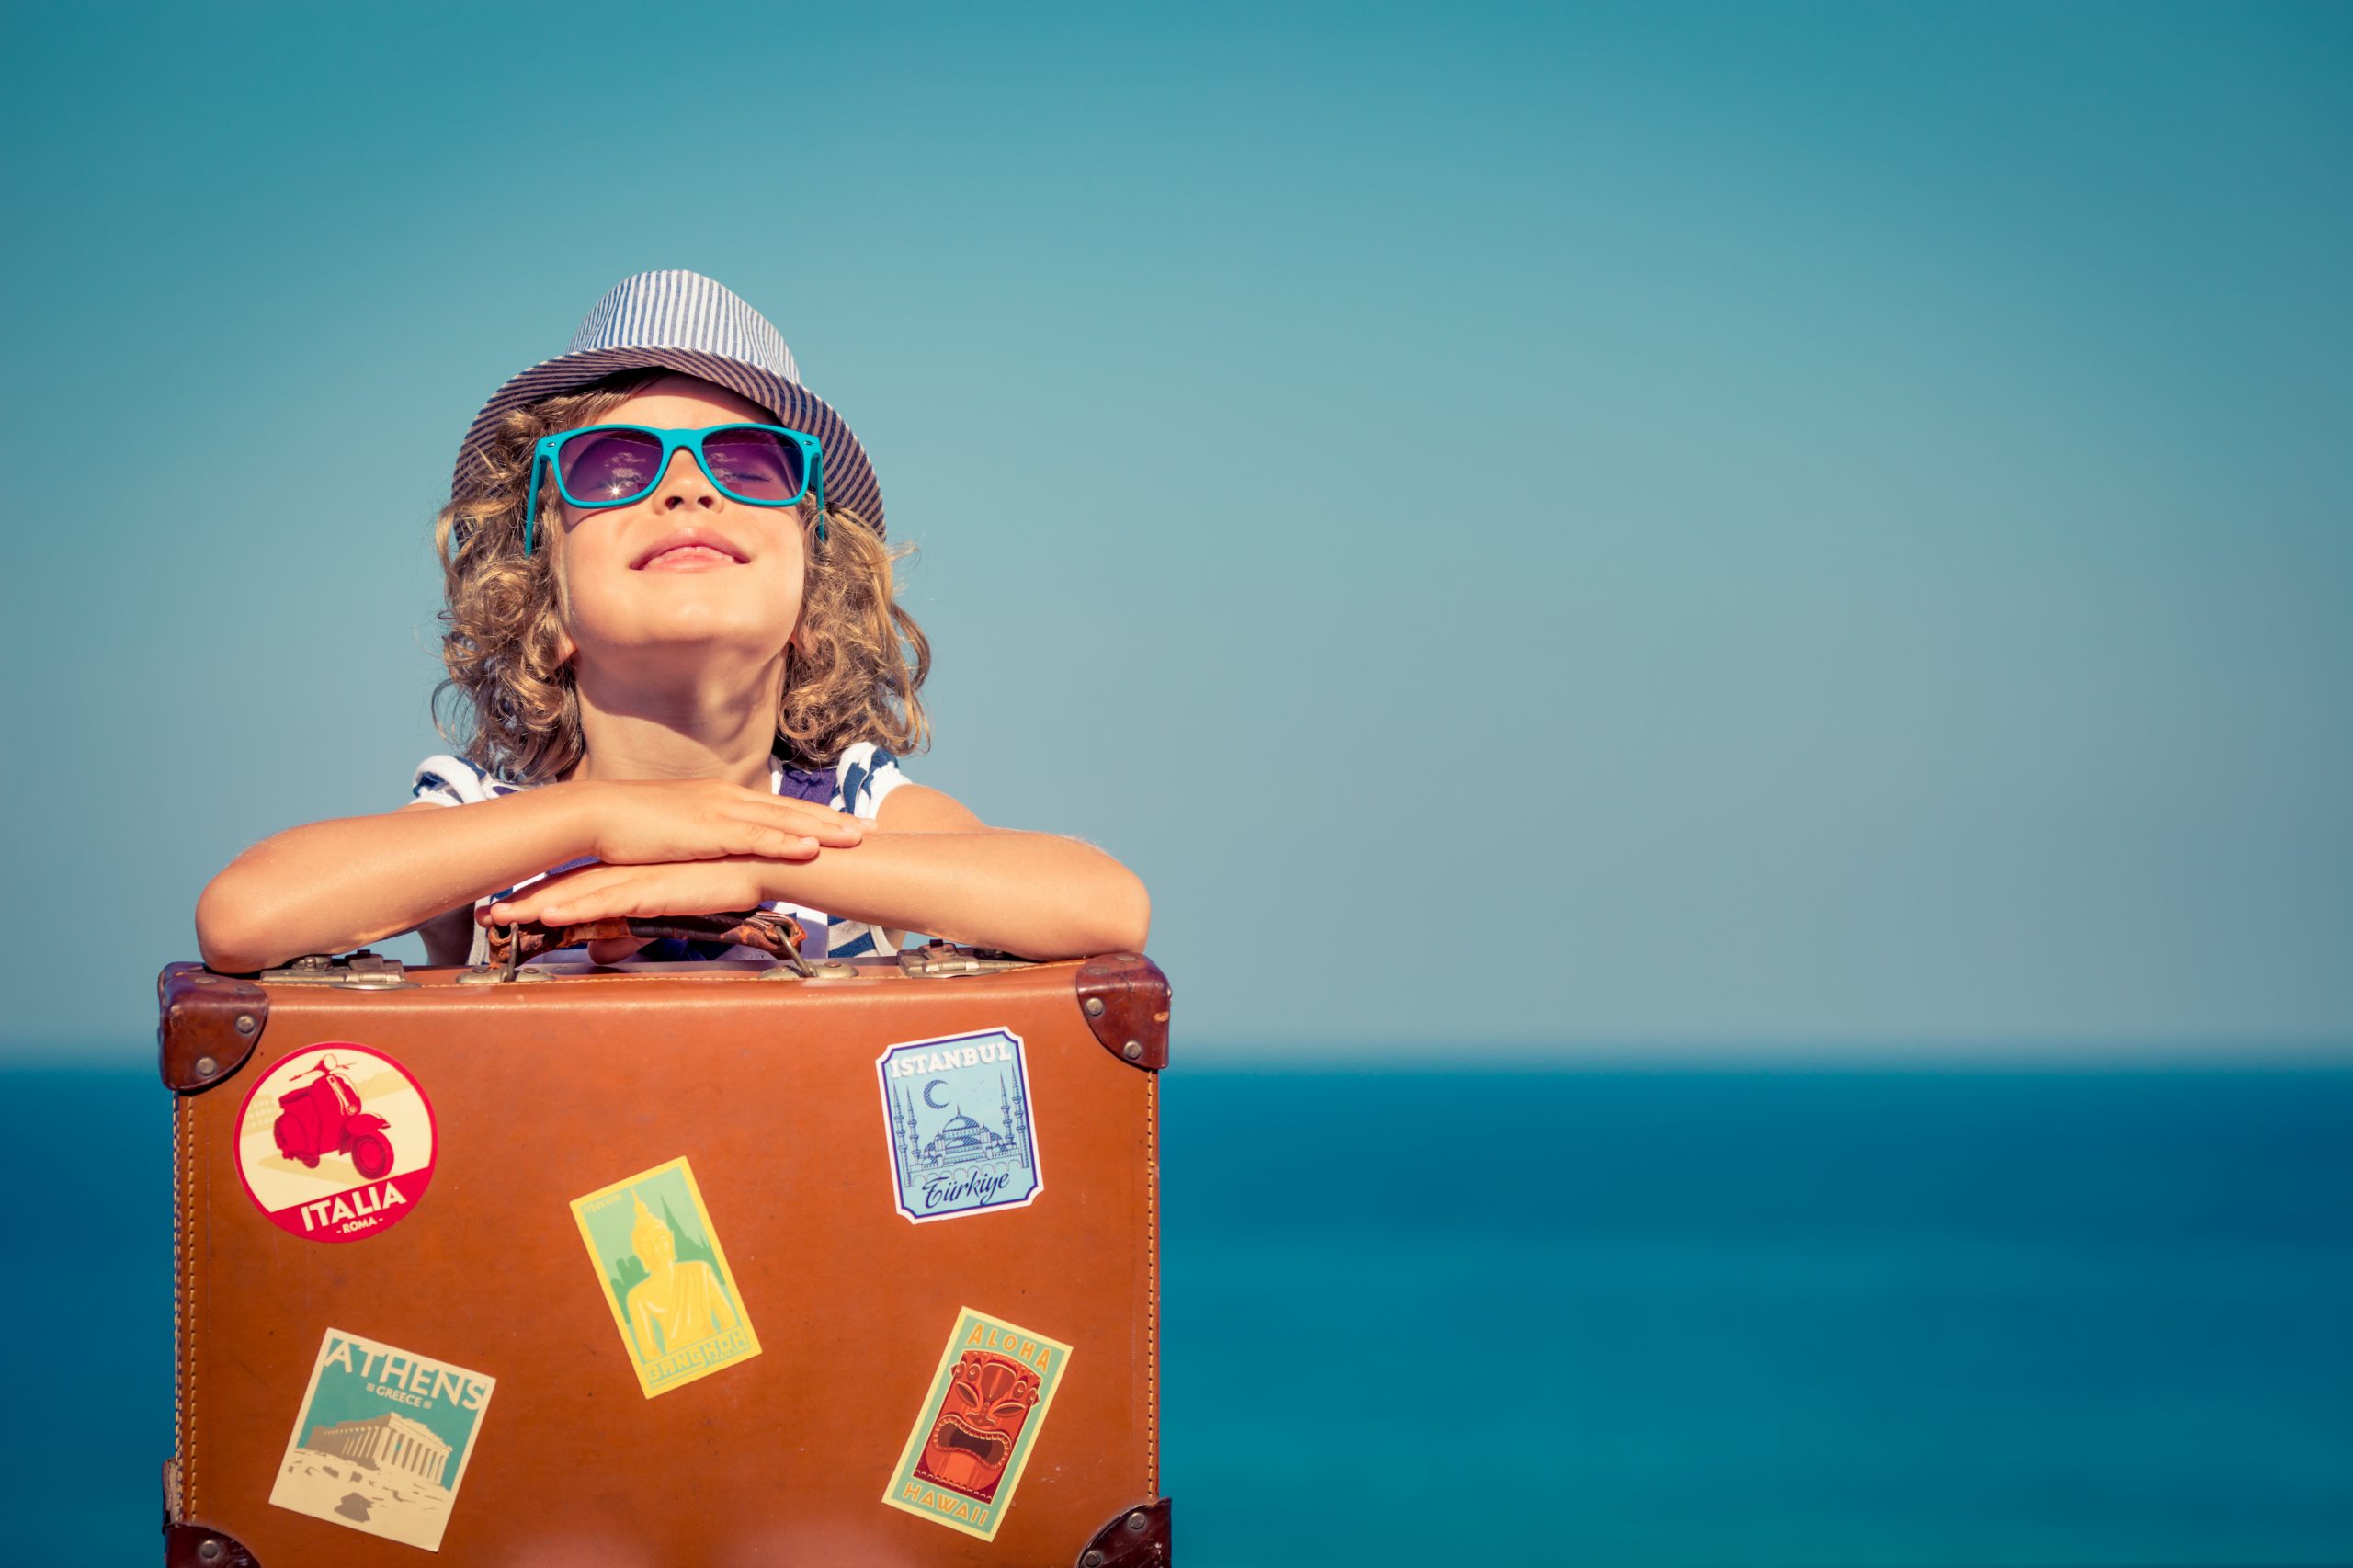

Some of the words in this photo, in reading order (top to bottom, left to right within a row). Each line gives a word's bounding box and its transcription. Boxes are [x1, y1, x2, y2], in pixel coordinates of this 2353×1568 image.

[889, 1041, 1011, 1079] ISTANBUL
[301, 1181, 407, 1232] ITALIA
[921, 1170, 1009, 1209] Türkiye
[645, 1327, 750, 1380] BANGKOK
[965, 1323, 1052, 1373] ALOHA
[324, 1341, 486, 1411] ATHENS
[376, 1384, 421, 1407] GREECE
[903, 1482, 990, 1527] HAWAII
